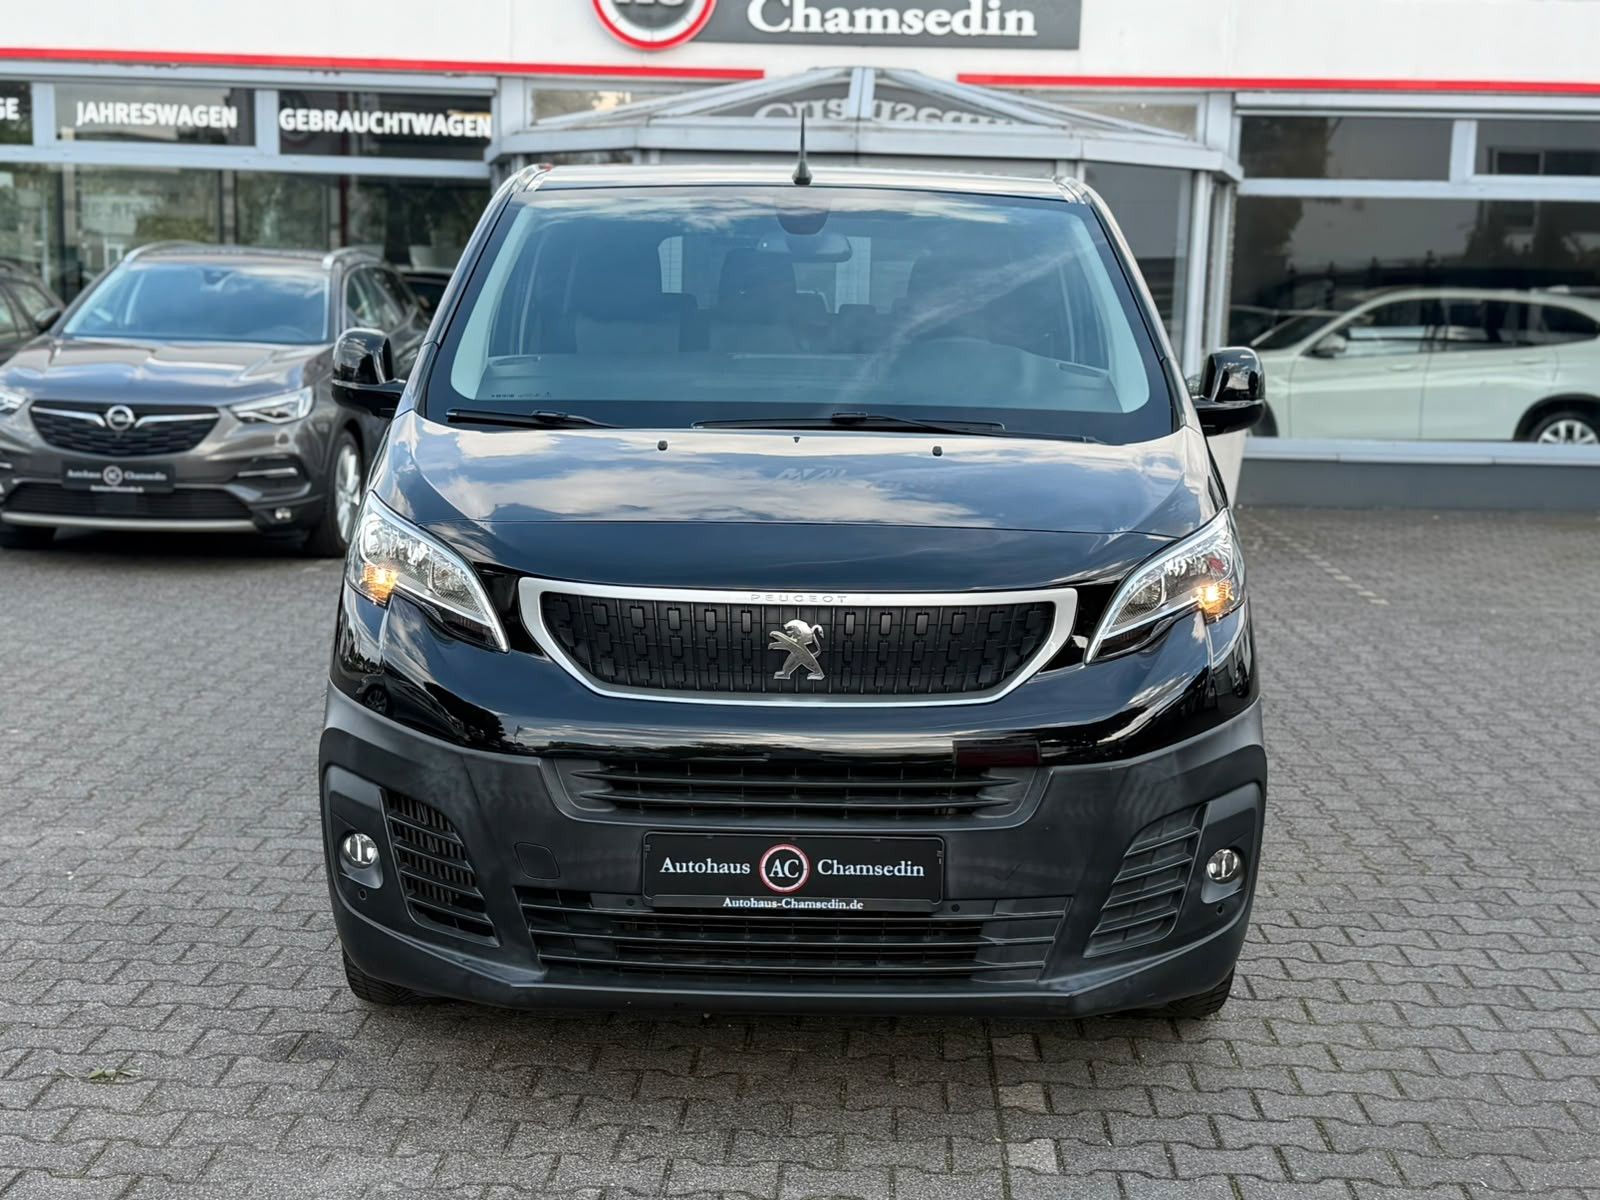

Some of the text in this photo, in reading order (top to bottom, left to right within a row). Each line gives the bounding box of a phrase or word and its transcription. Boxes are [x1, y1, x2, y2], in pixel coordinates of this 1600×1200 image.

[747, 0, 1037, 36] Chamsedin
[76, 101, 238, 128] JAHRESWAGEN
[279, 108, 492, 138] GEBRAUCHTWAGEN
[750, 593, 847, 604] PEUGEOT
[659, 856, 925, 879] Autohaus AC Chamsedin
[722, 897, 864, 911] Autohaus-Chamsedin.de
